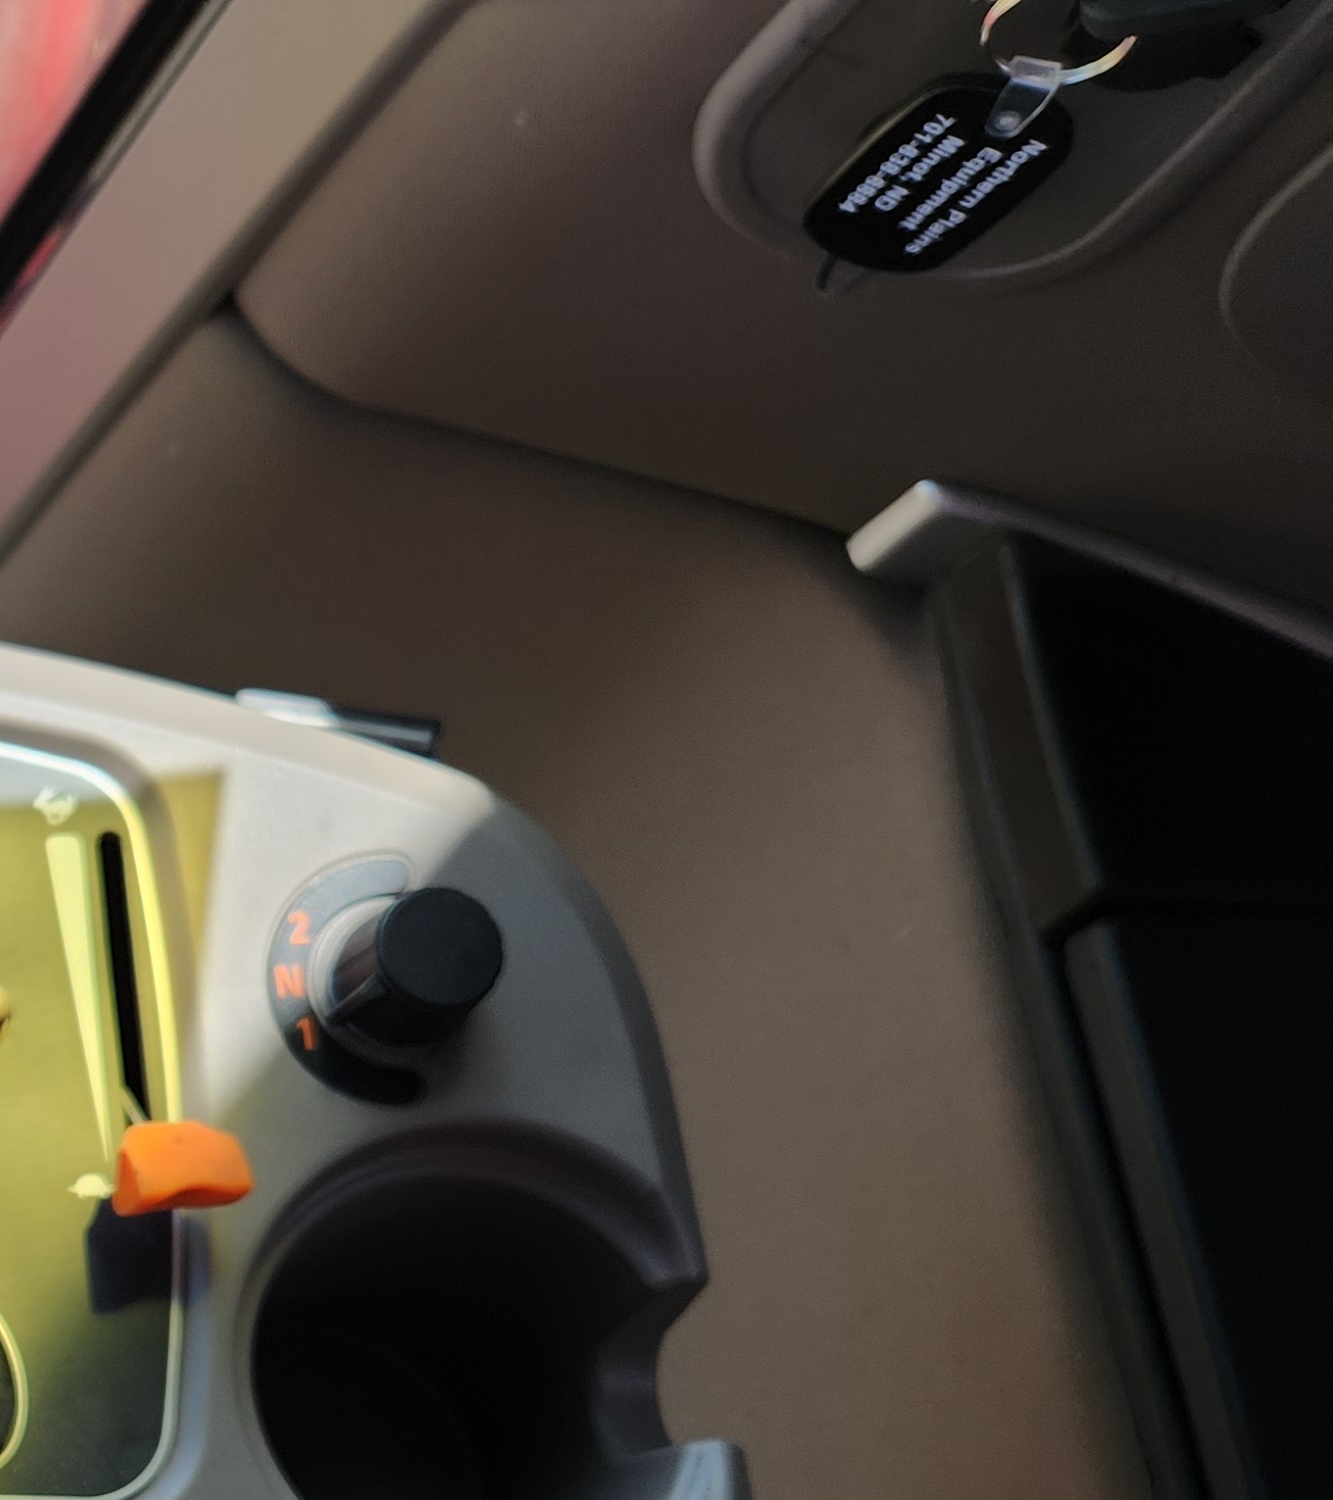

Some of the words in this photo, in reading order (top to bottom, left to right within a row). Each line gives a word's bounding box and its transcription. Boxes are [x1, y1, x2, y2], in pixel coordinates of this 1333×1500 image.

[898, 134, 966, 183] Minot,
[958, 138, 1049, 209] Northern
[874, 184, 910, 212] ND
[897, 145, 1004, 232] Equipment
[903, 208, 967, 256] Plains
[286, 910, 311, 946] 2
[273, 964, 307, 1000] N
[295, 1016, 319, 1052] 1
